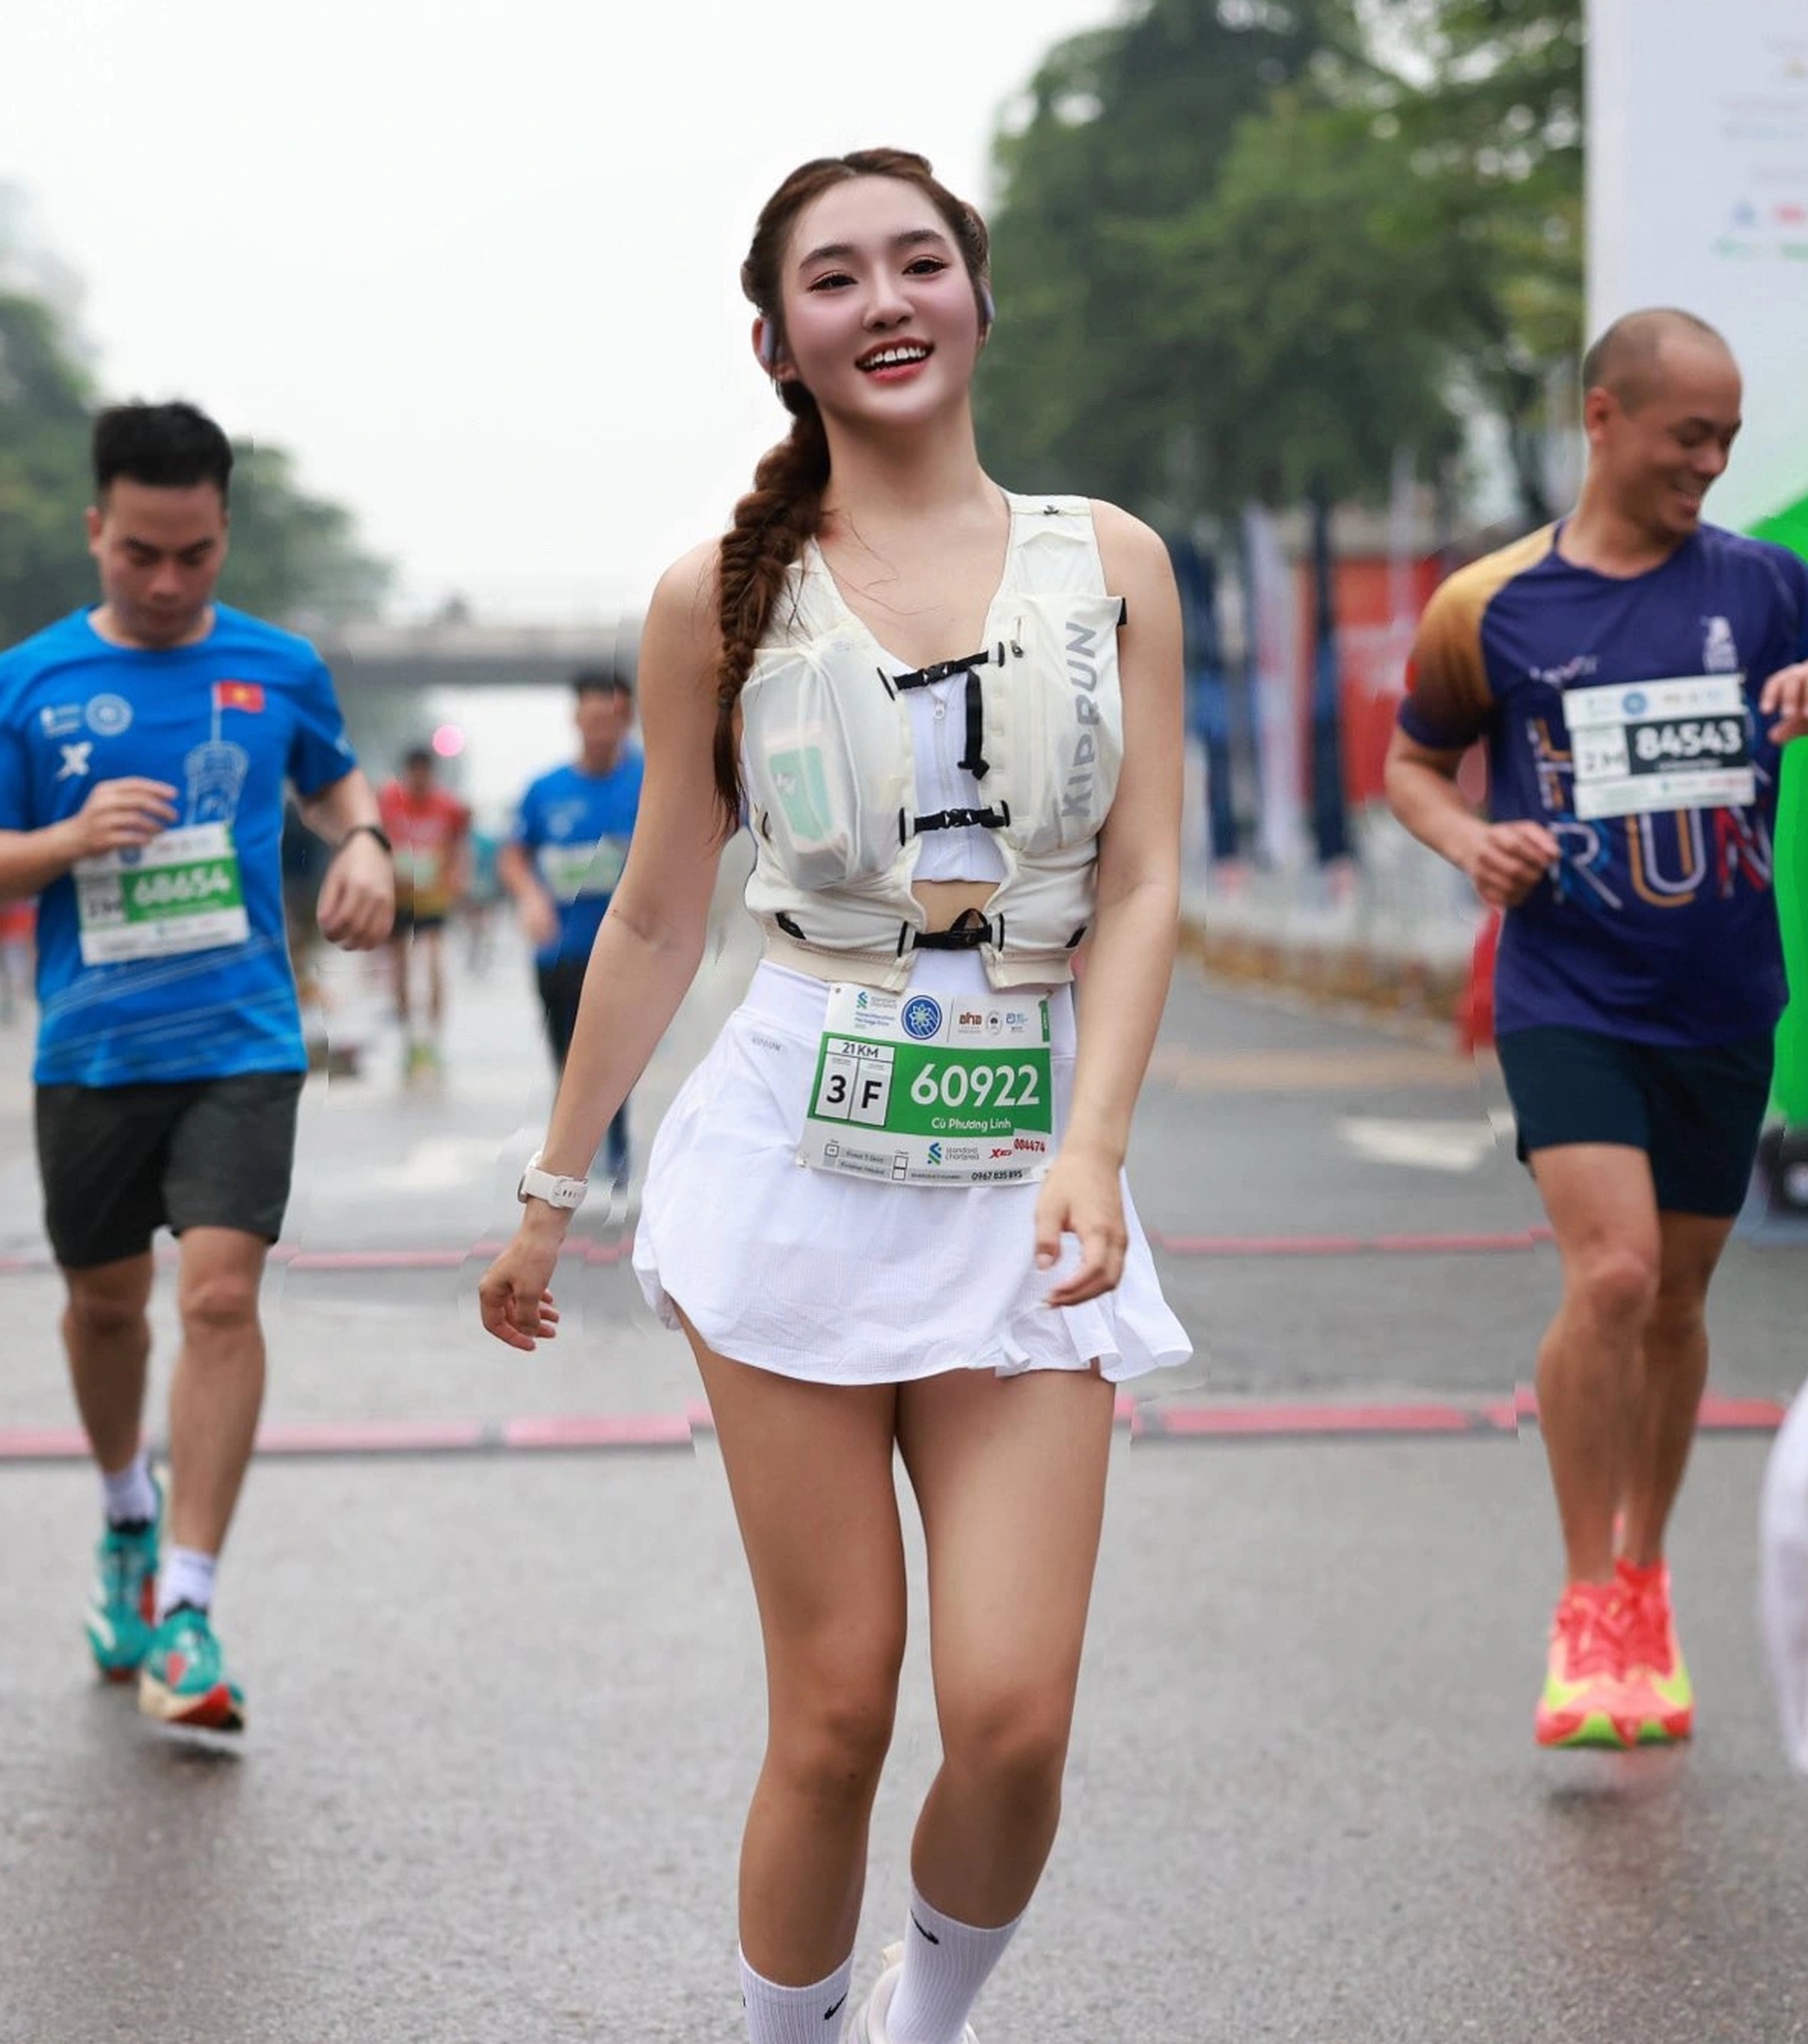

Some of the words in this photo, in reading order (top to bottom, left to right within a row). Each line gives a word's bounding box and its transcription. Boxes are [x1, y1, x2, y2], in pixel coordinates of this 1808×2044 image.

[1061, 621, 1100, 819] KIPRUN
[826, 1074, 847, 1103] 3
[861, 1080, 882, 1109] F
[910, 1063, 1041, 1107] 60922
[990, 1118, 1012, 1129] Linh
